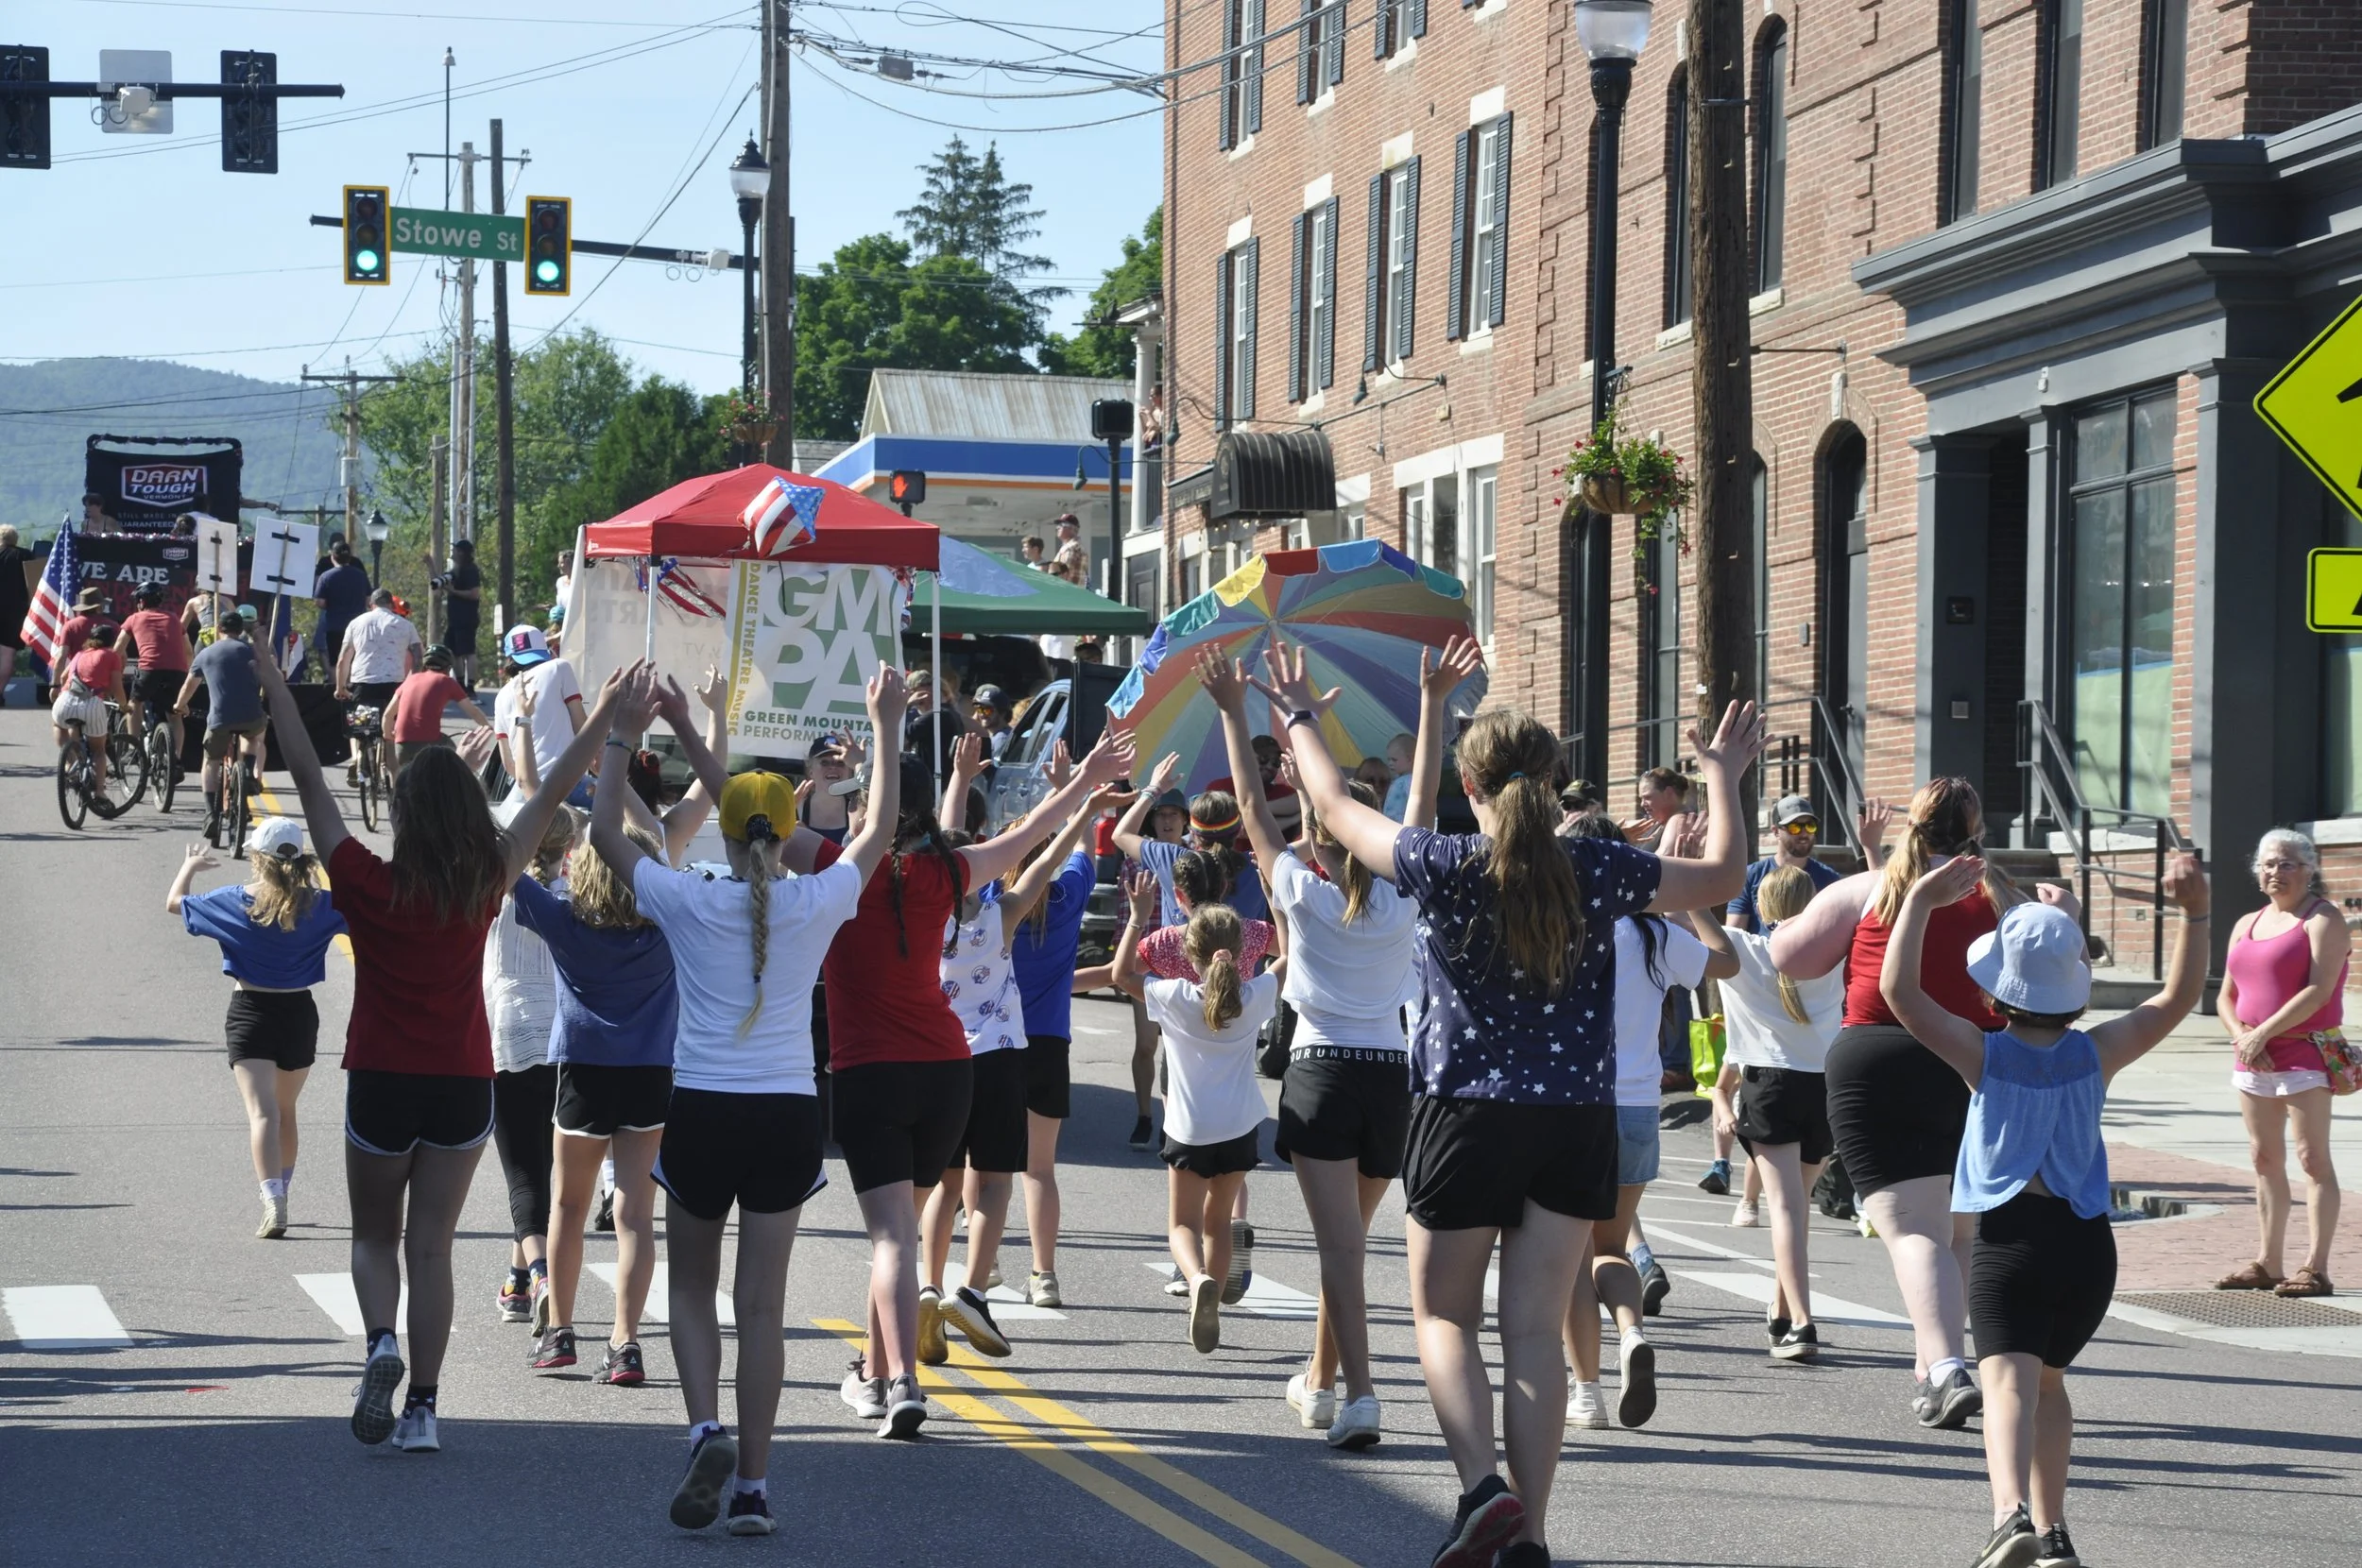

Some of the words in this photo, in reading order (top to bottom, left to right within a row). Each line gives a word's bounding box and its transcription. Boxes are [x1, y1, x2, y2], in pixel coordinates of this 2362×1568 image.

[395, 217, 482, 249] Stowe
[497, 231, 518, 252] St
[130, 483, 197, 494] TOUGH
[131, 469, 198, 483] DARN
[116, 564, 170, 585] ARE
[745, 563, 762, 614] DANCE
[739, 619, 757, 684] THEATRE
[727, 689, 746, 737] MUSIC
[745, 710, 797, 725] GREEN
[803, 715, 875, 732] MOUNTA
